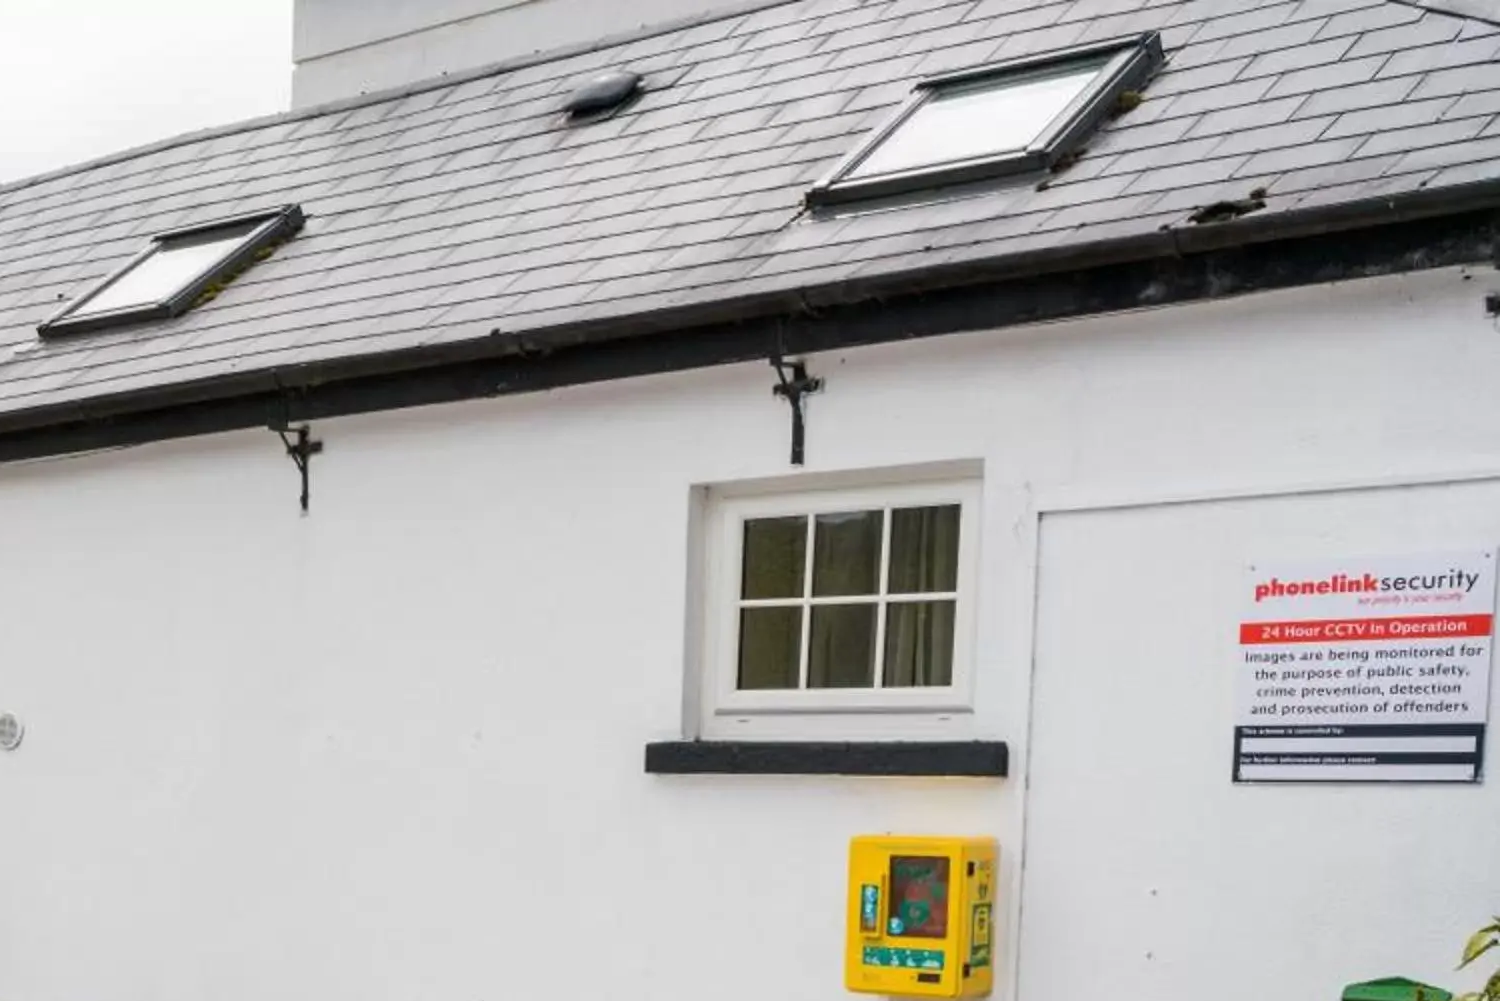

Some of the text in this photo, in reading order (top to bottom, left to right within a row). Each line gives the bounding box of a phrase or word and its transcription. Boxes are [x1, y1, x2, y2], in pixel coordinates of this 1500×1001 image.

[1255, 568, 1480, 602] phonelinksecurity
[1261, 619, 1467, 639] 24 Hour CCTV In Operation
[1245, 643, 1484, 664] Images are being monitored for
[1255, 668, 1277, 680] the
[1281, 668, 1342, 681] purpose
[1346, 665, 1364, 678] of
[1367, 664, 1413, 679] public
[1256, 683, 1462, 699] crime prevention, detection
[1250, 701, 1469, 716] and prosecution of offenders
